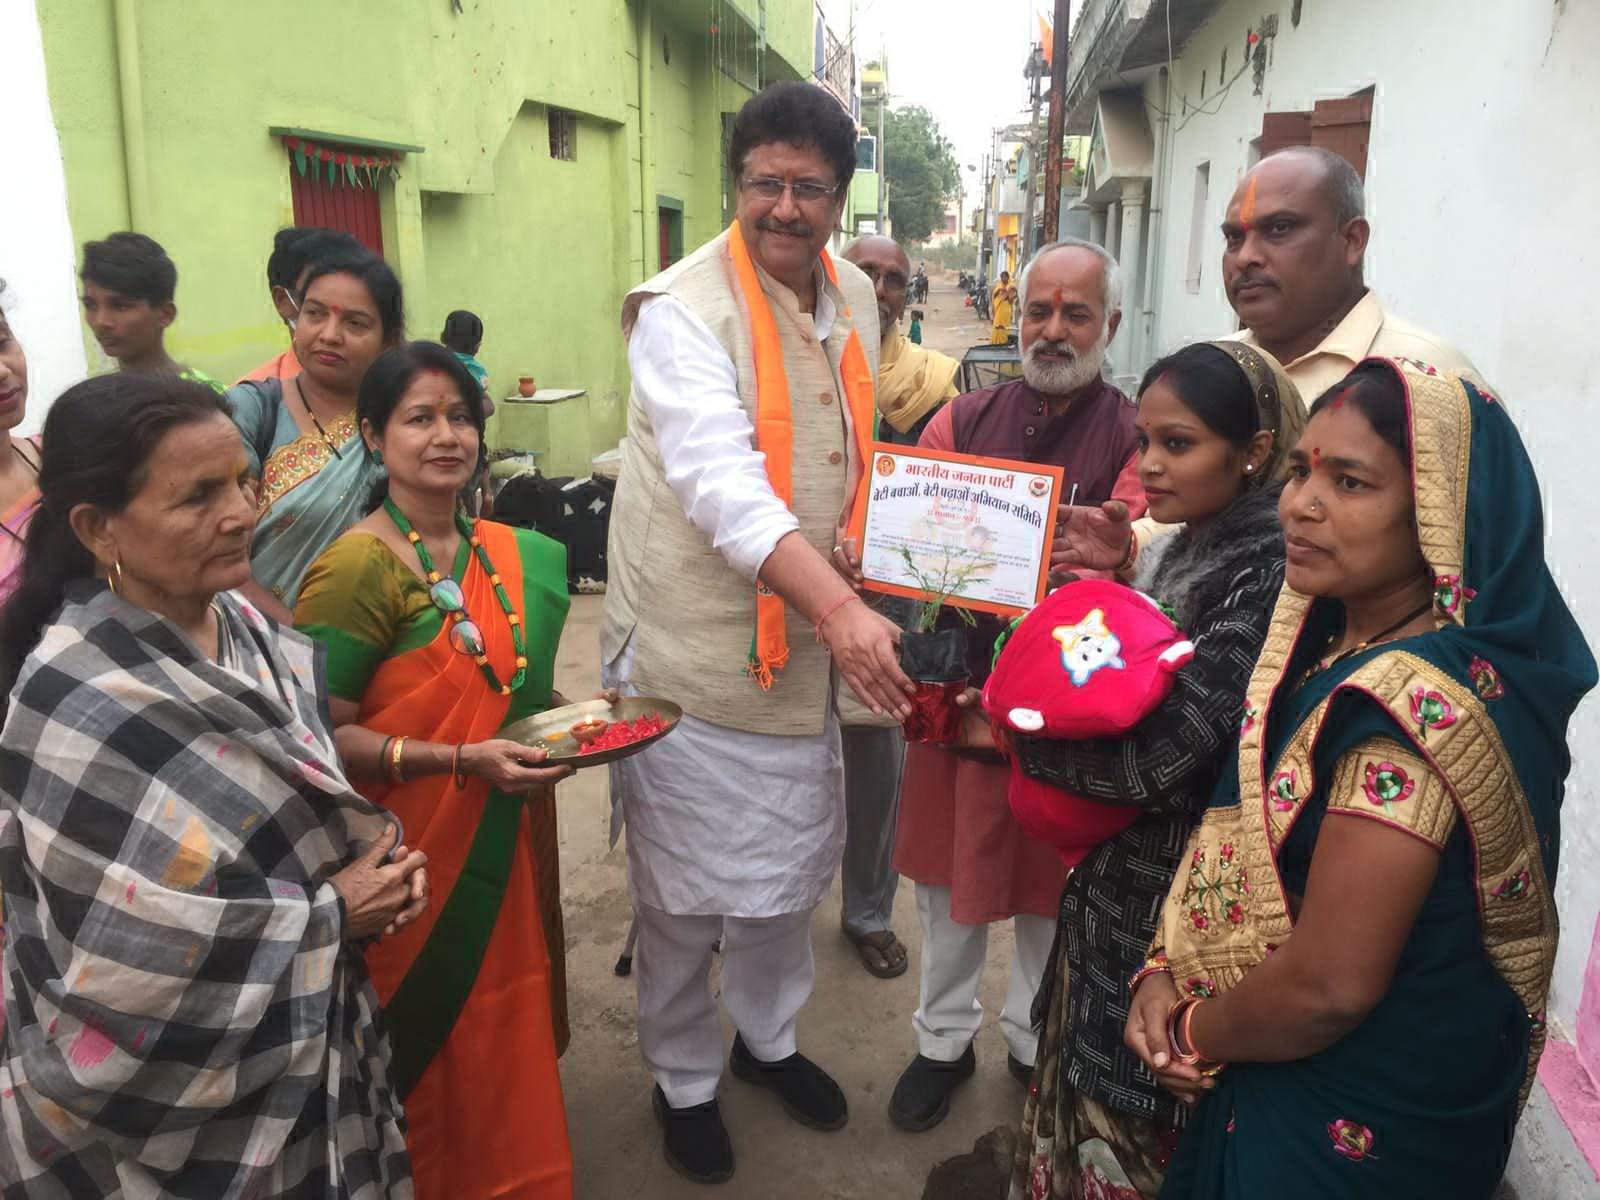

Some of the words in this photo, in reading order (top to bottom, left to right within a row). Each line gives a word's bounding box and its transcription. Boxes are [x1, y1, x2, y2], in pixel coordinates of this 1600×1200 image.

[905, 463, 949, 481] भारतीय
[952, 470, 986, 486] जनता
[988, 473, 1016, 490] पार्टी
[873, 484, 889, 501] बेटी
[923, 481, 940, 497] बेटी
[970, 489, 1010, 513] अभियान
[1011, 502, 1042, 529] समिति
